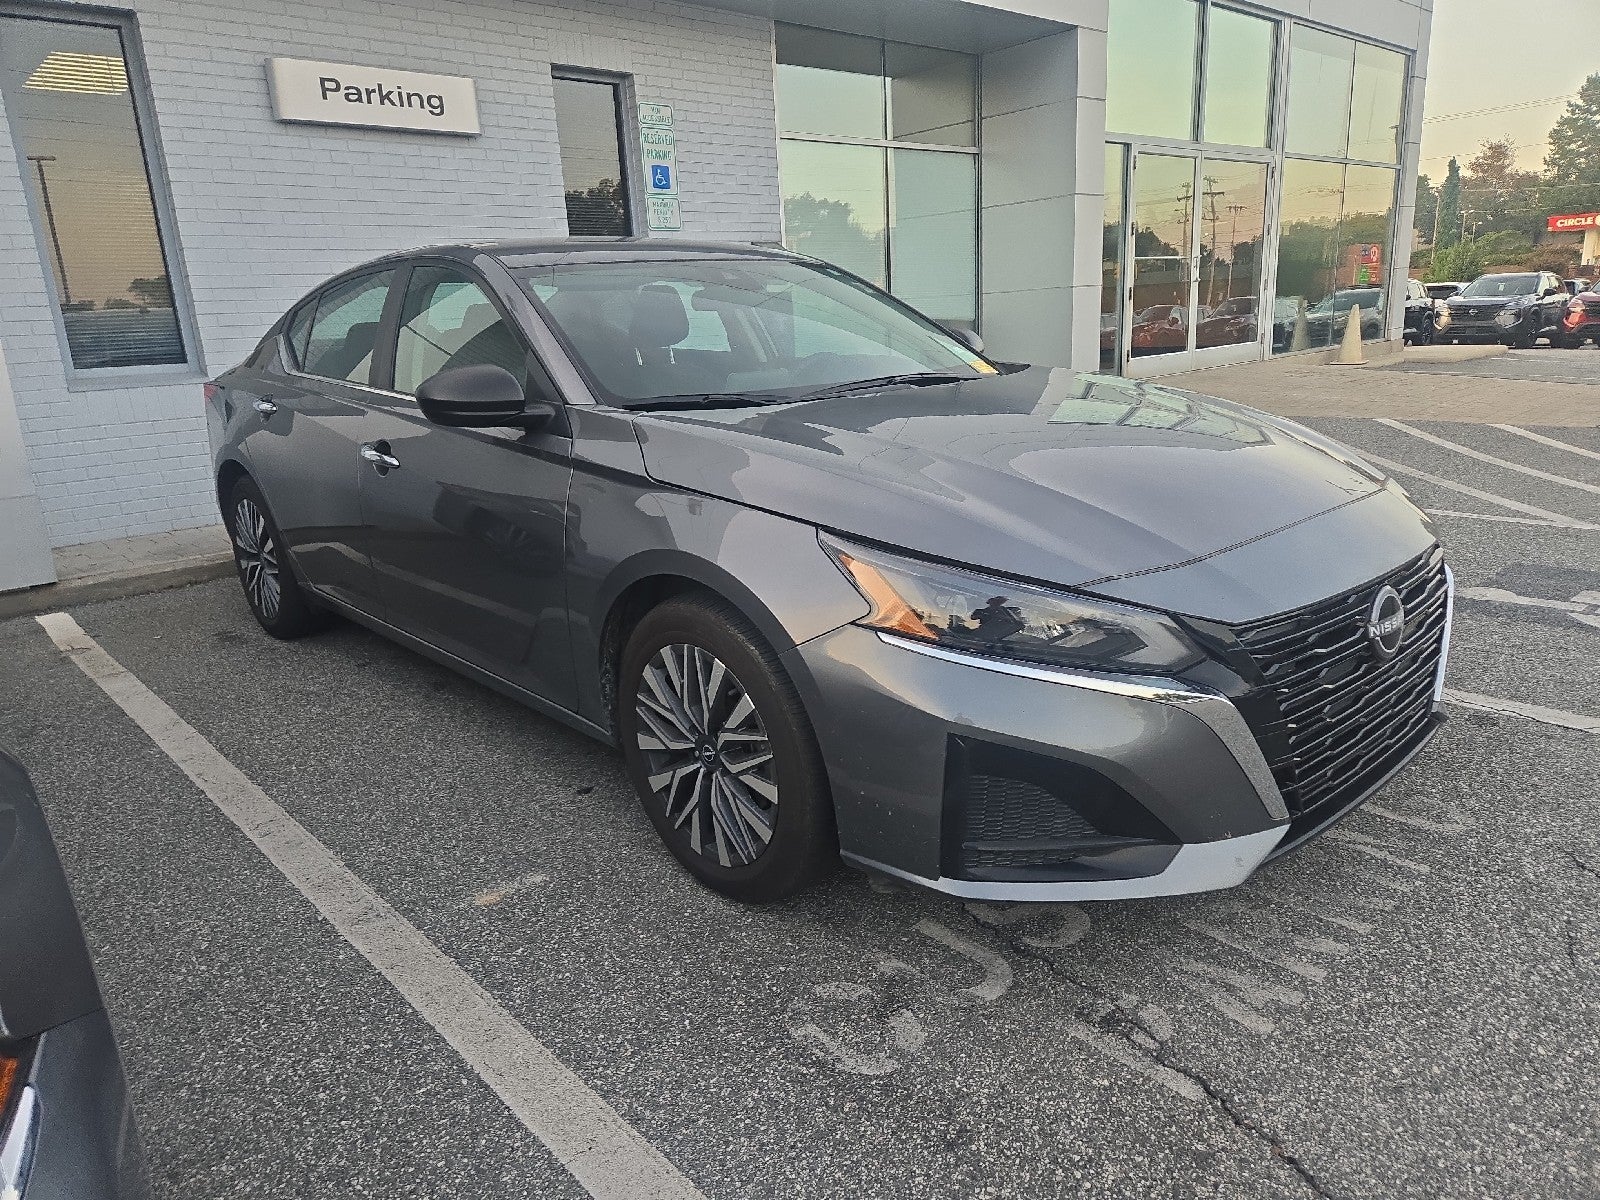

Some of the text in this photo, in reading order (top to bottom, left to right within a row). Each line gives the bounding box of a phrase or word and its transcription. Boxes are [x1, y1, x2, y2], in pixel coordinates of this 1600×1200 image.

[318, 76, 445, 117] Parking
[643, 132, 673, 146] RESERVED
[646, 148, 672, 160] PARKING
[1556, 216, 1594, 227] CIRCLE
[1369, 615, 1403, 637] NISS
